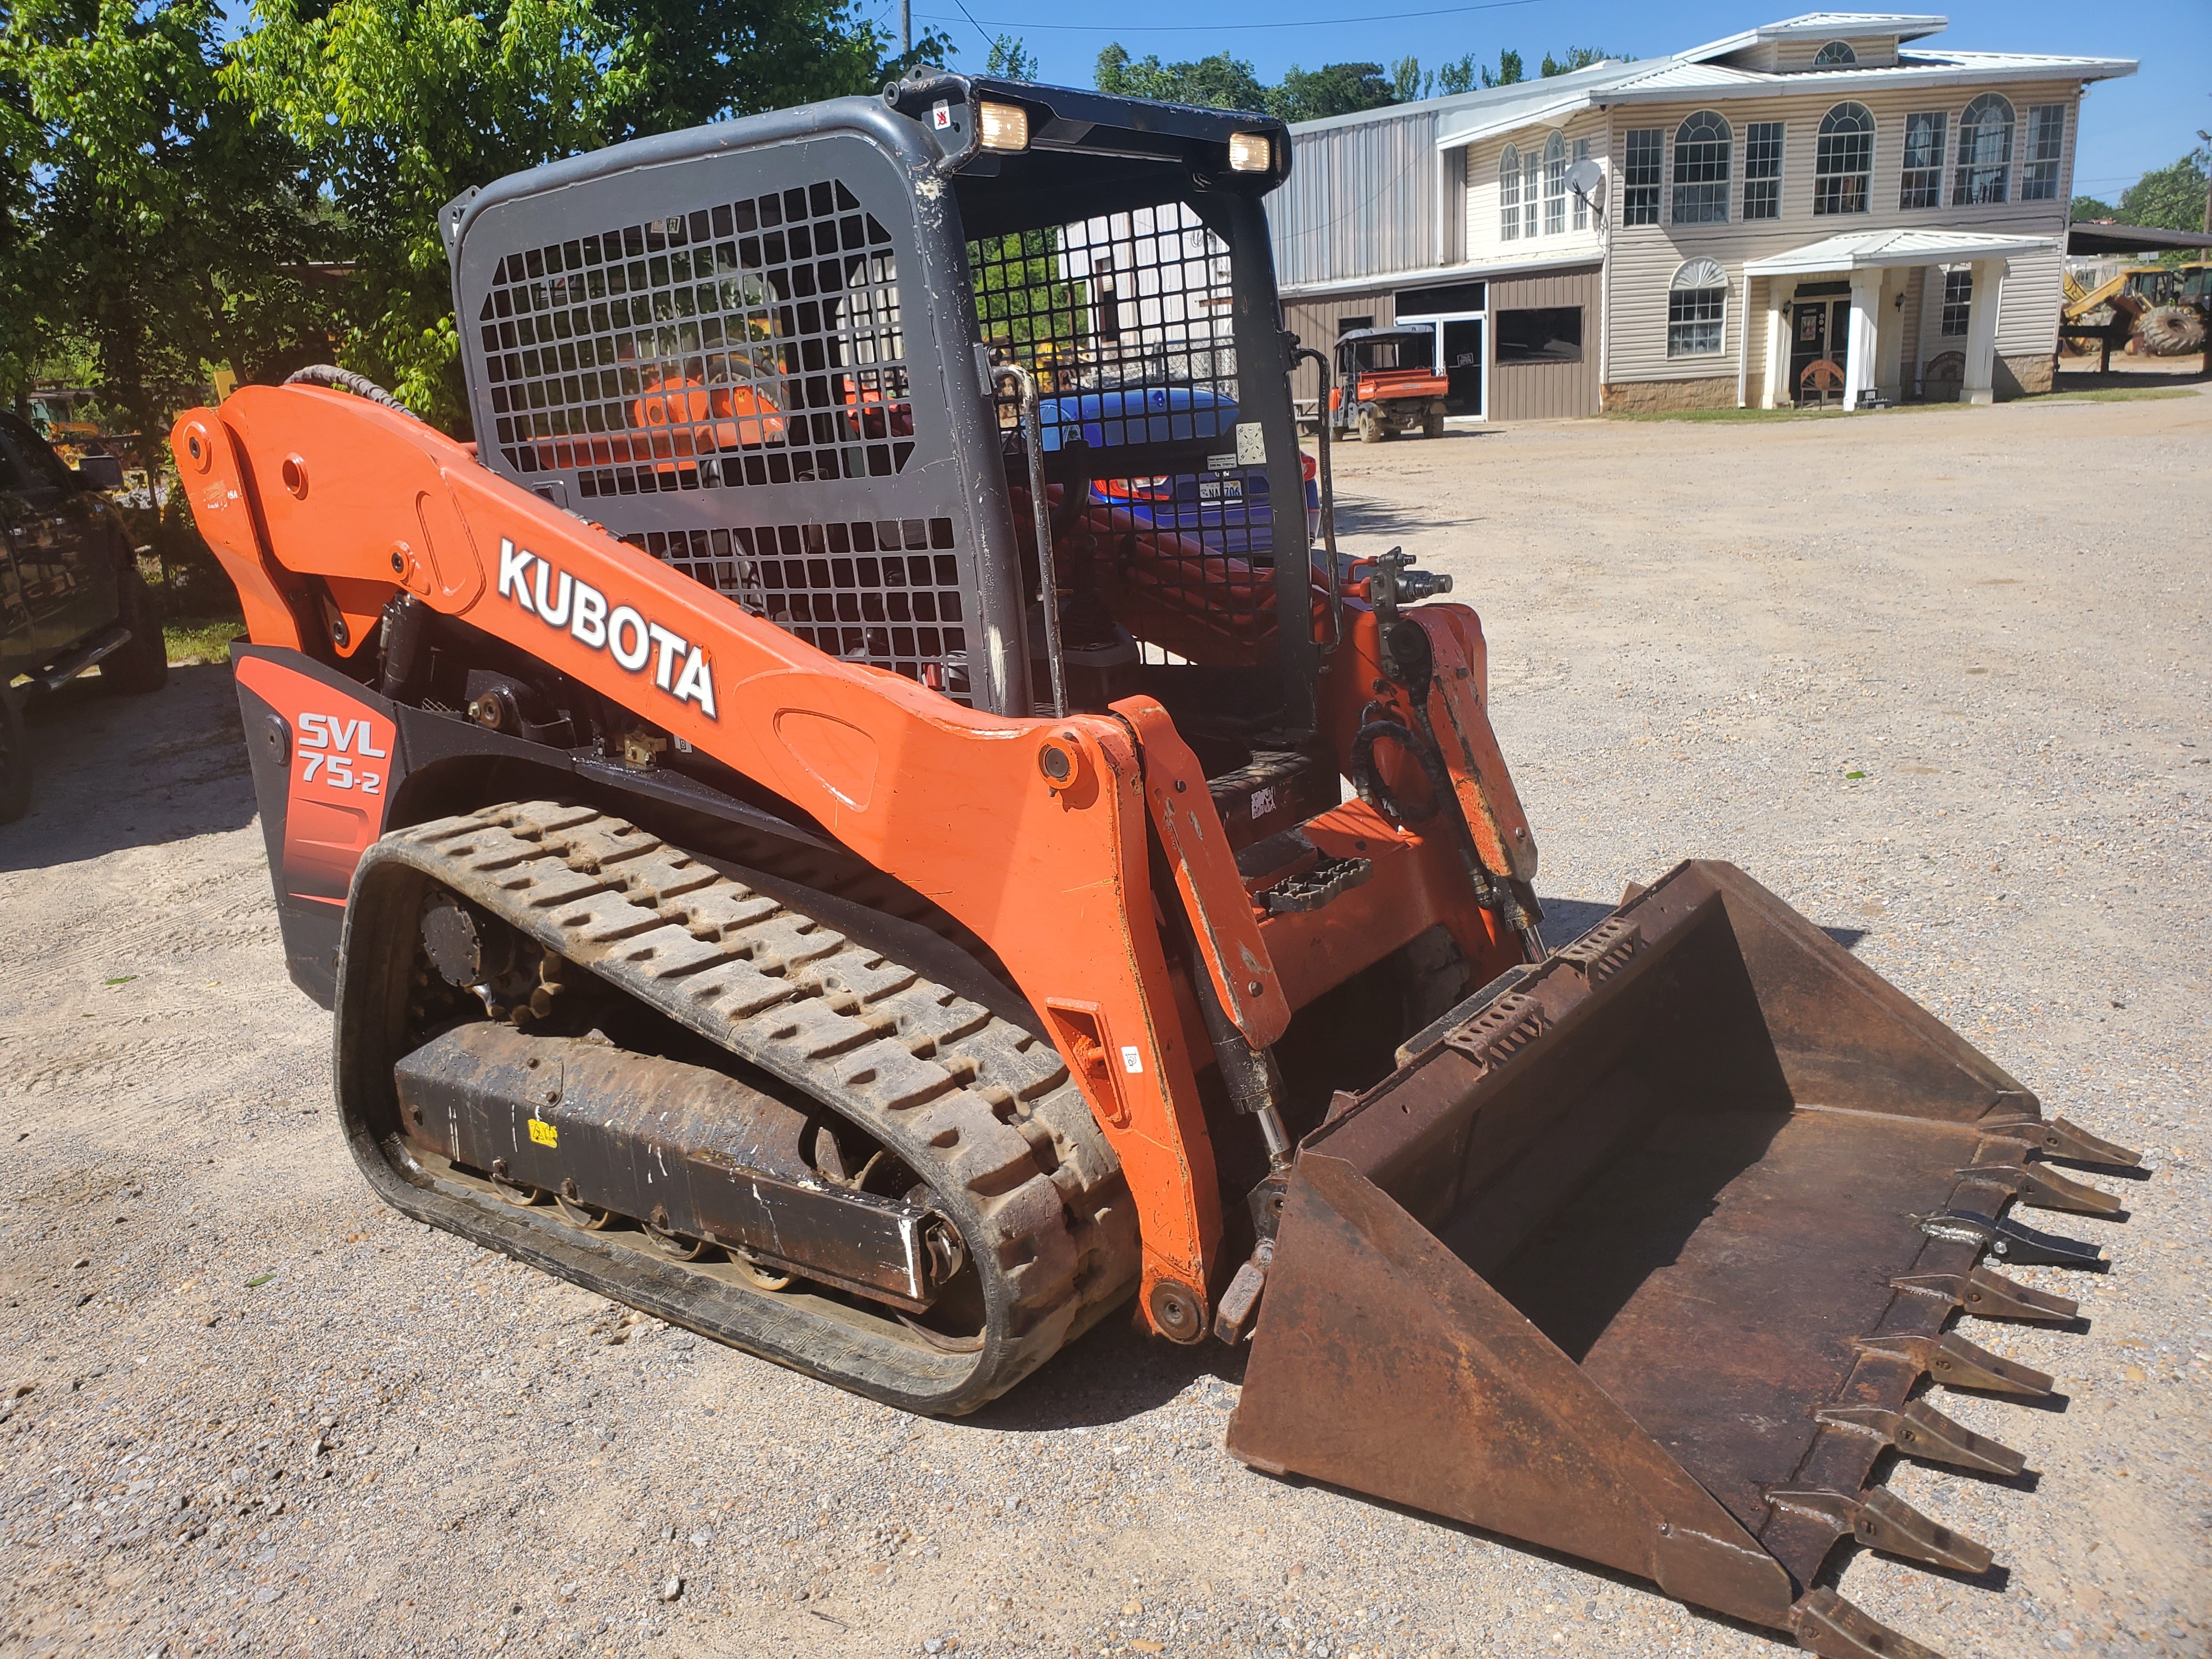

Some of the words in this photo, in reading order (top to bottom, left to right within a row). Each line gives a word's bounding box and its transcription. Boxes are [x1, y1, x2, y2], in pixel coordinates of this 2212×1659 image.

[498, 537, 716, 719] KUBOTA
[298, 712, 386, 758] SVL
[297, 750, 381, 795] 75-2
